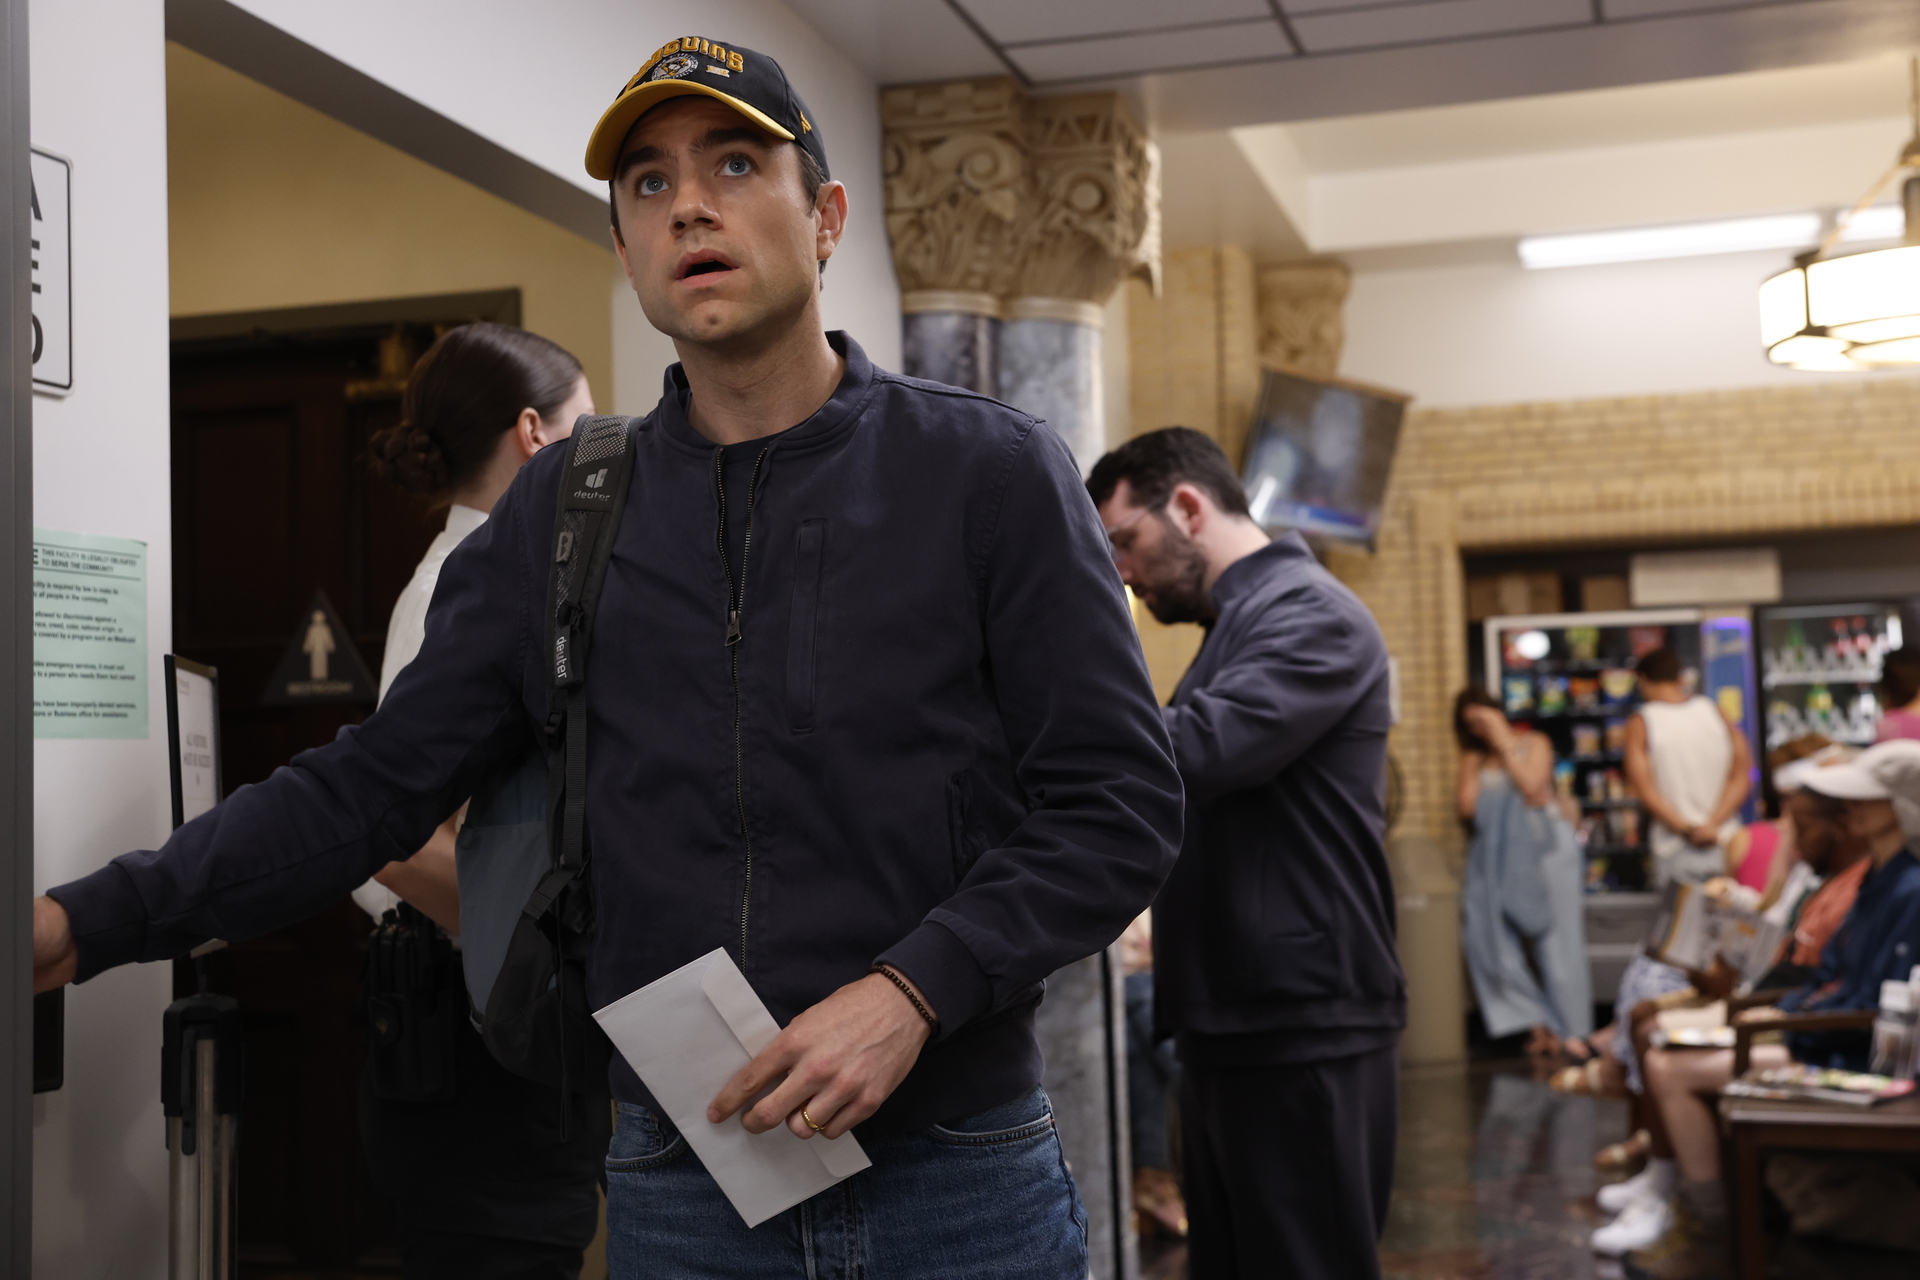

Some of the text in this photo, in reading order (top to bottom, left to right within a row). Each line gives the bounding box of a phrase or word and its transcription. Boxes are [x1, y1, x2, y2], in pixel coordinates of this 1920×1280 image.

[573, 489, 610, 501] deuter
[56, 550, 80, 559] FACILITY
[51, 560, 68, 568] SERVE
[82, 563, 114, 572] COMMUNITY
[556, 636, 568, 678] deuter
